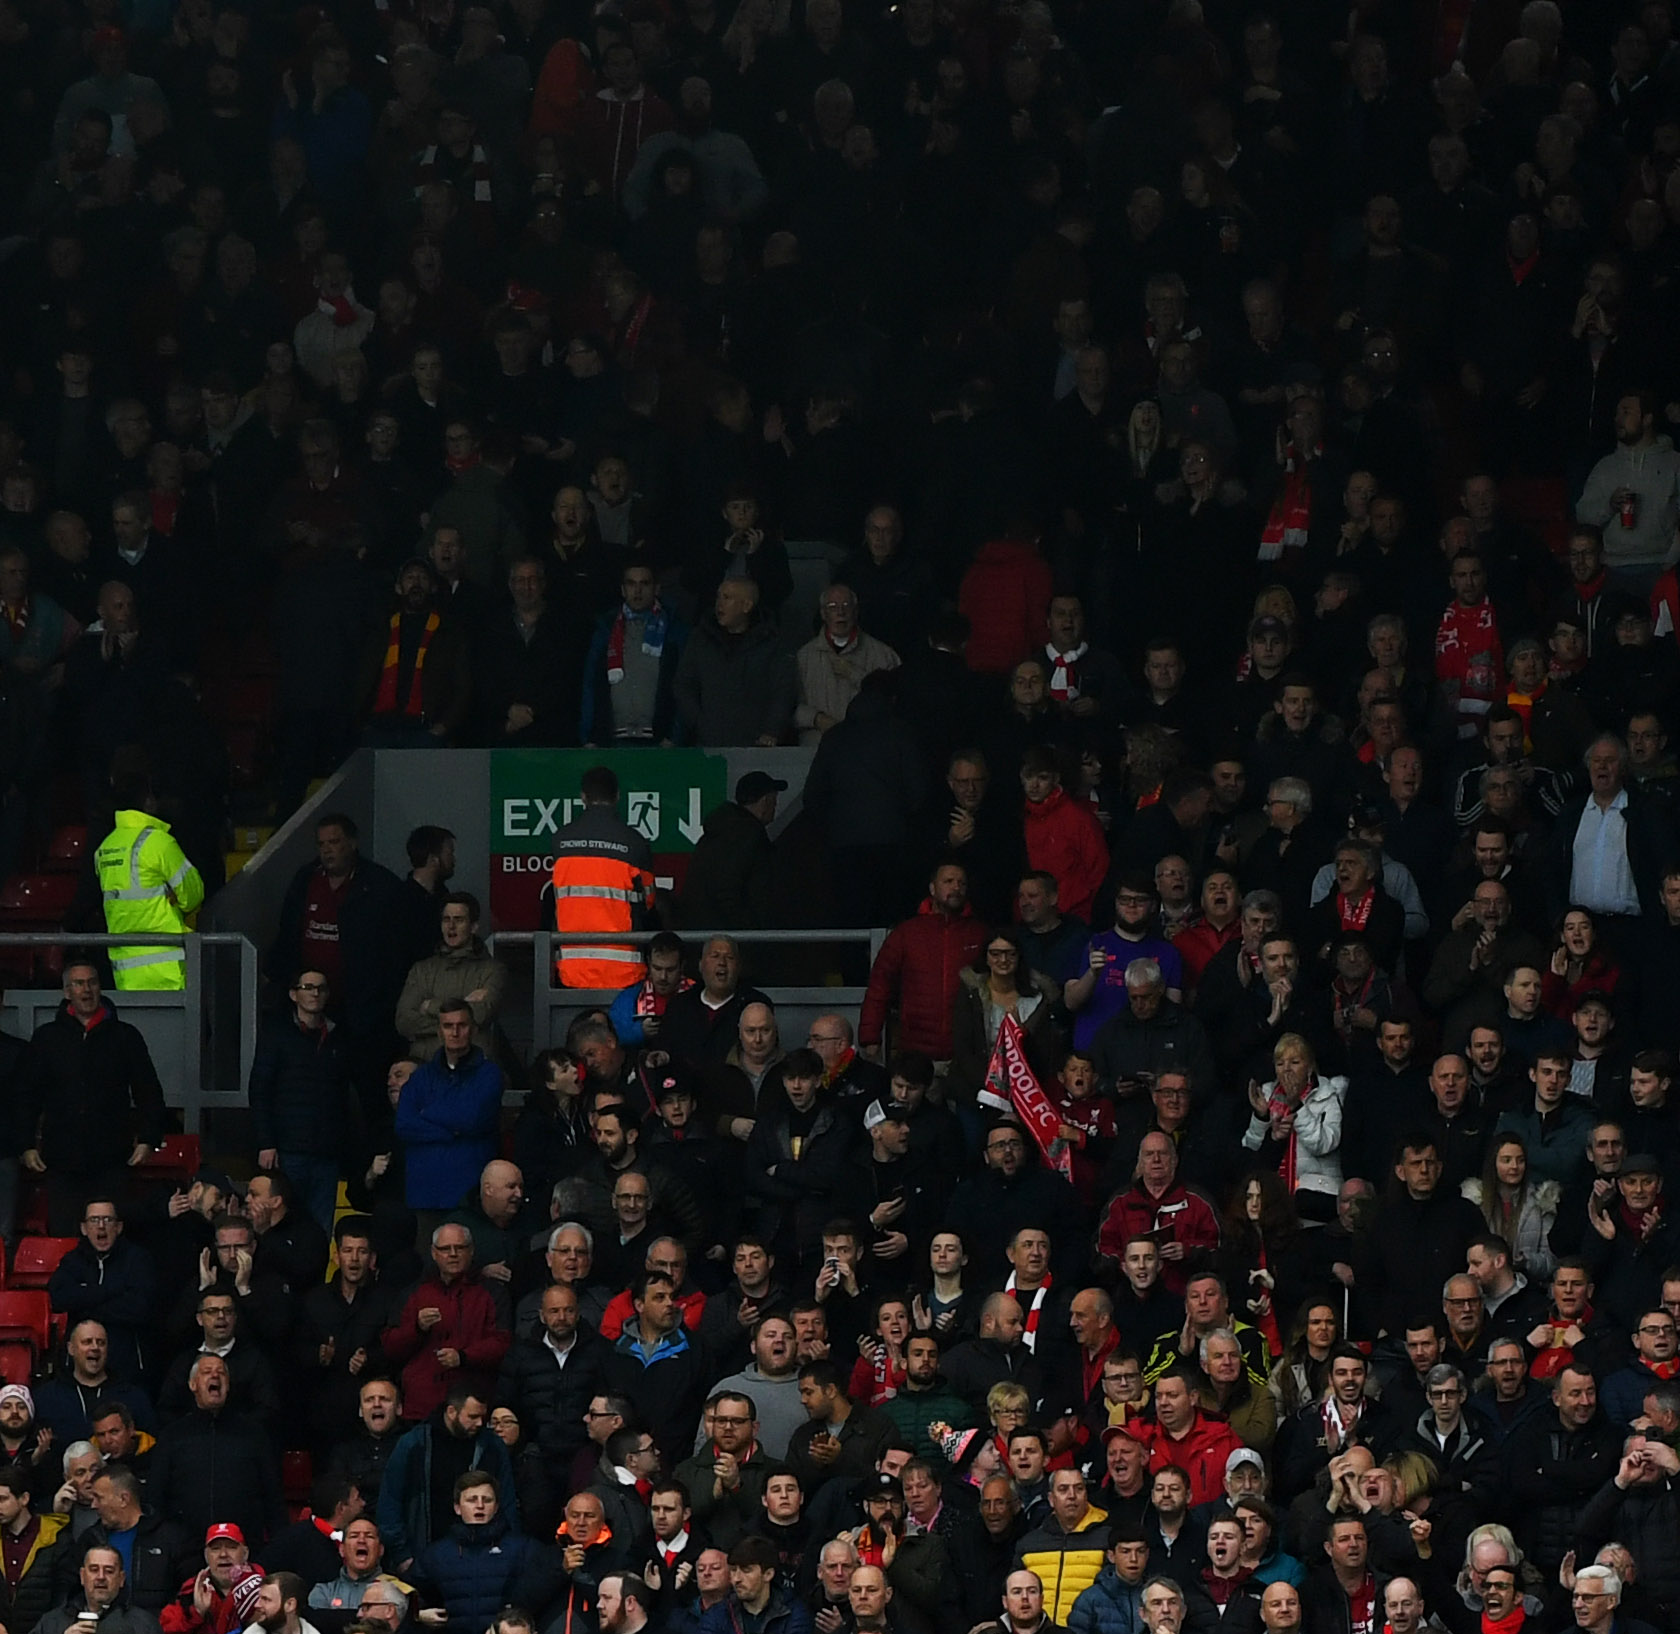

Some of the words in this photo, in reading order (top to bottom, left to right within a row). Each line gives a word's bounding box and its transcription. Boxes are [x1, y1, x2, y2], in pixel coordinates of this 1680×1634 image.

[560, 839, 586, 850] CROWD
[589, 841, 629, 854] STEWARD
[502, 855, 554, 873] BLOC
[1032, 1101, 1058, 1128] FC
